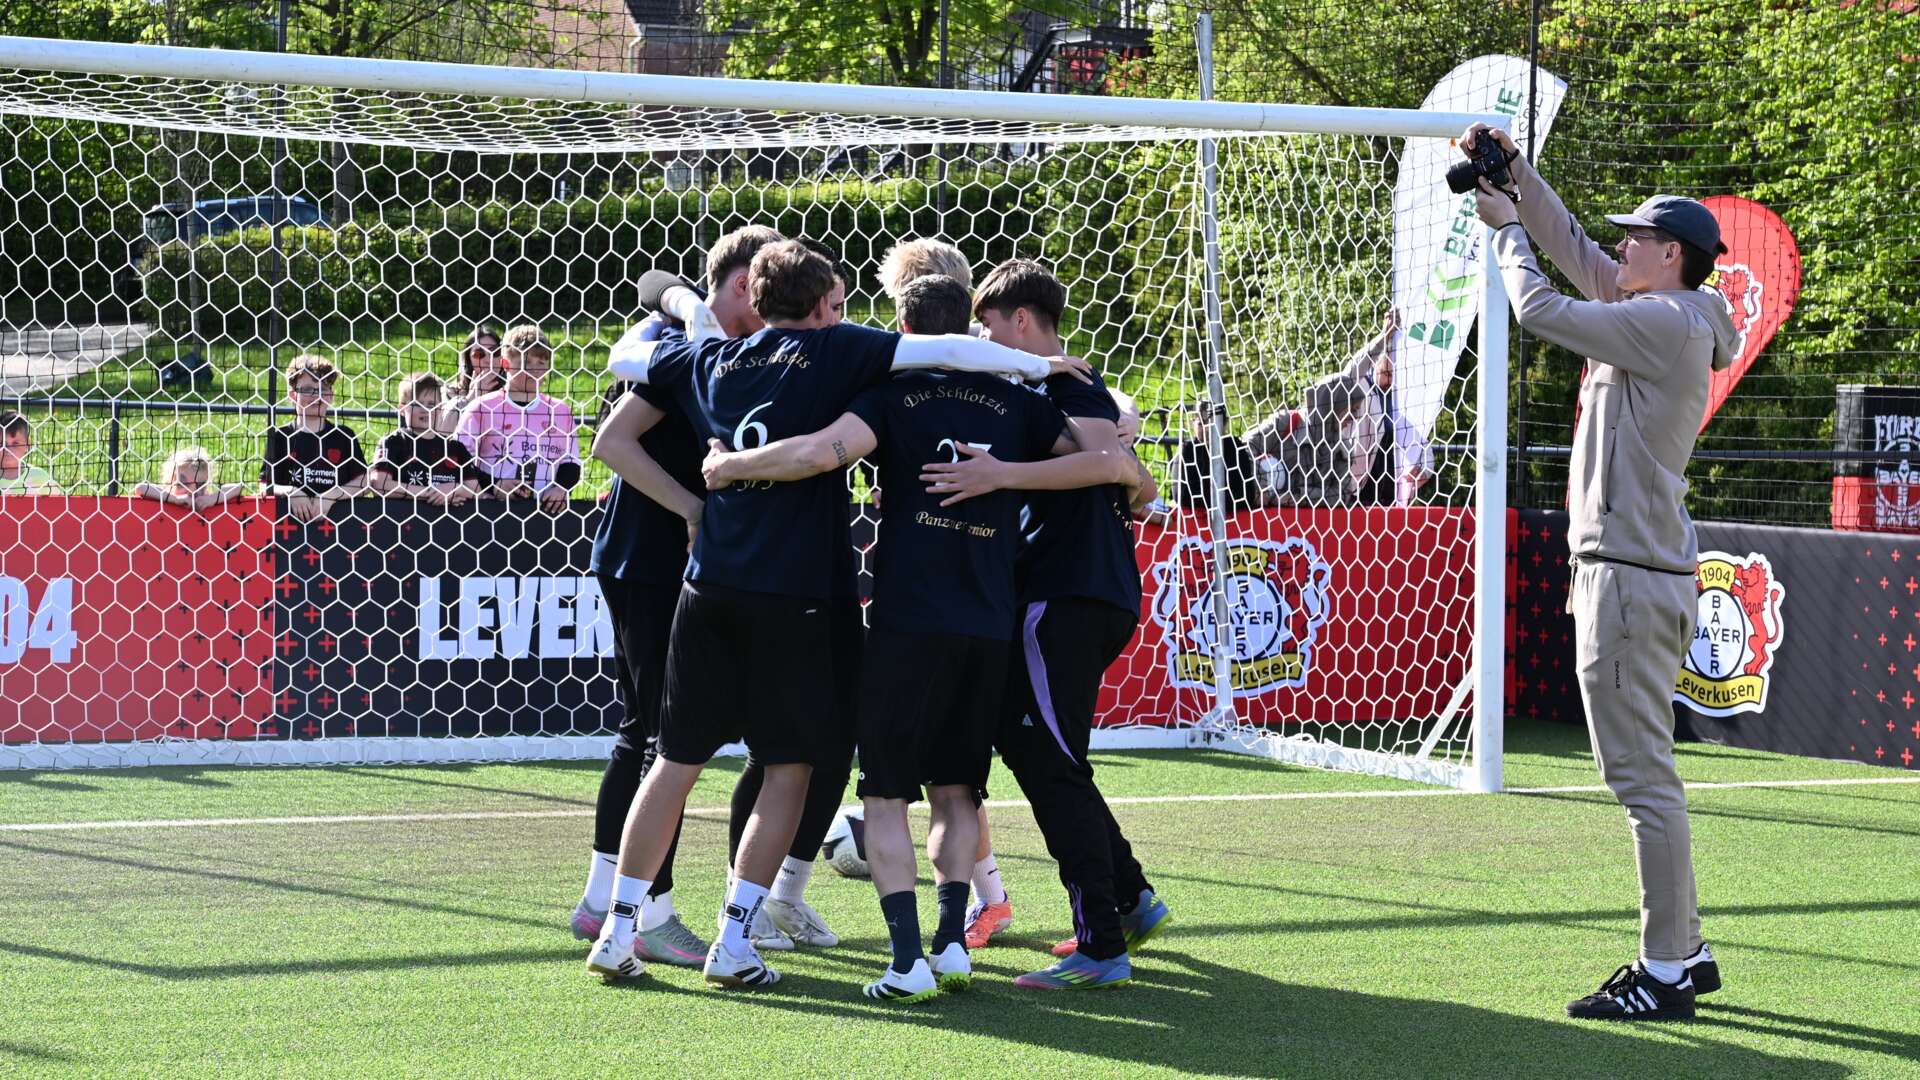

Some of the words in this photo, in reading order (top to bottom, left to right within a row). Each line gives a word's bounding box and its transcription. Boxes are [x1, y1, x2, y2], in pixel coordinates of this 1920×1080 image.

[715, 360, 741, 378] Die
[904, 389, 932, 408] Die
[936, 385, 1007, 416] Schlotzis
[733, 401, 773, 452] 6
[1702, 567, 1731, 584] 1904
[0, 576, 78, 664] 04
[1233, 579, 1249, 657] BAYER
[1710, 595, 1721, 675] BAYER
[1184, 661, 1294, 685] Levrkusen
